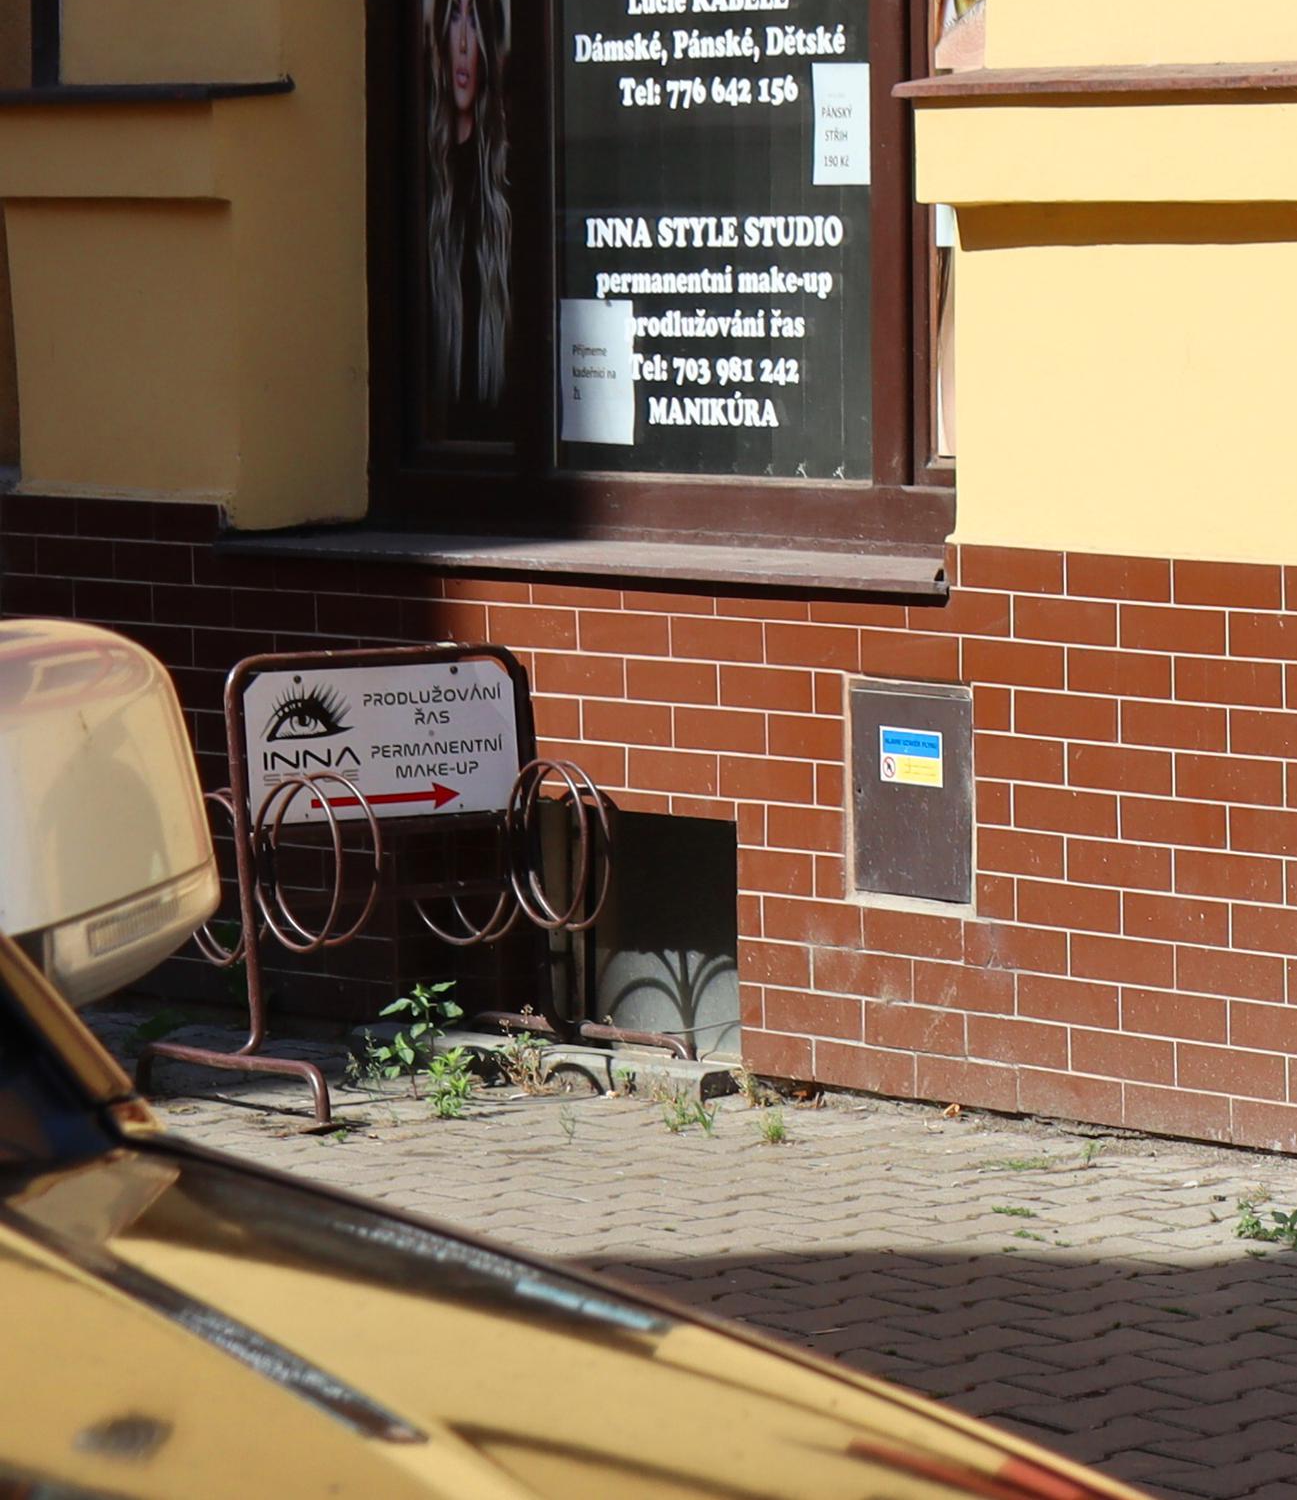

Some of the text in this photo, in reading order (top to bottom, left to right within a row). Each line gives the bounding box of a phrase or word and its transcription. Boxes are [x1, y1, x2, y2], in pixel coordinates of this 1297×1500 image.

[574, 24, 845, 65] Dámské, Pánské, Dětské
[619, 75, 798, 109] Tel: 776 642 156
[586, 215, 843, 247] INNA STYLE STUDIO
[596, 265, 833, 299] permanentní make-up
[624, 309, 805, 342] prodlužování řas
[629, 352, 799, 385] Tel: 703 981 242
[648, 391, 779, 427] MANIKÚRA
[362, 682, 501, 707] PRODLUŽOVÁNÍ
[414, 708, 450, 726] ŘAS
[263, 746, 361, 771] INNA
[370, 734, 502, 759] PERMANENTNÍ
[395, 760, 479, 779] MAKE-UP
